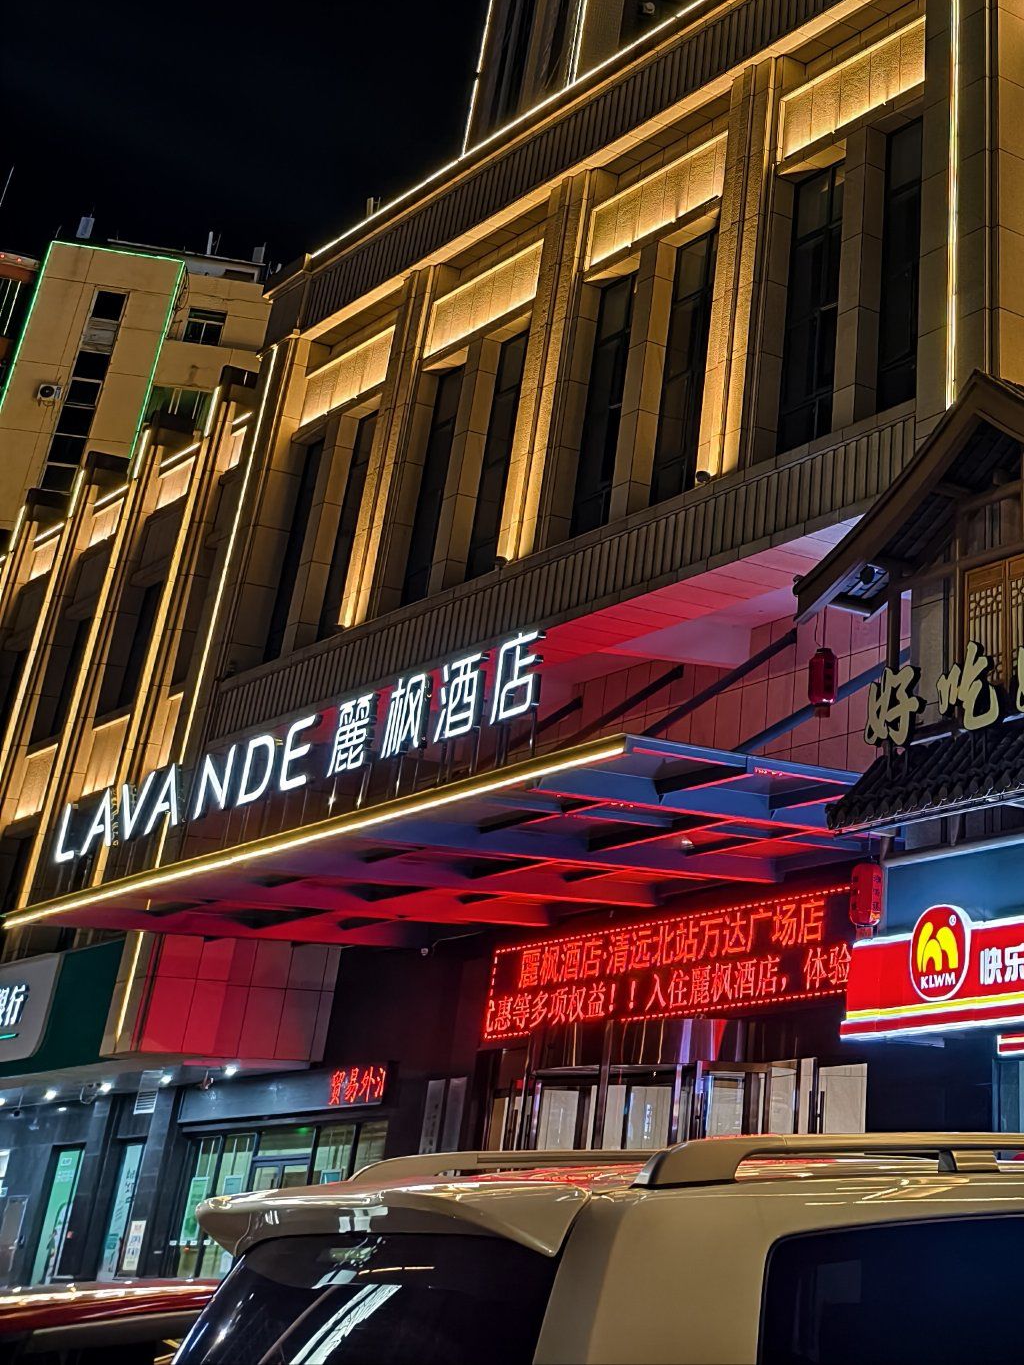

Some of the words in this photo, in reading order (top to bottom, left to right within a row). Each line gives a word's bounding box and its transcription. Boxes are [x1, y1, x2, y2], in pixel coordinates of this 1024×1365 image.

[54, 714, 319, 863] LAVANDE
[327, 630, 541, 777] 麗枫酒店
[920, 971, 956, 989] KLWM
